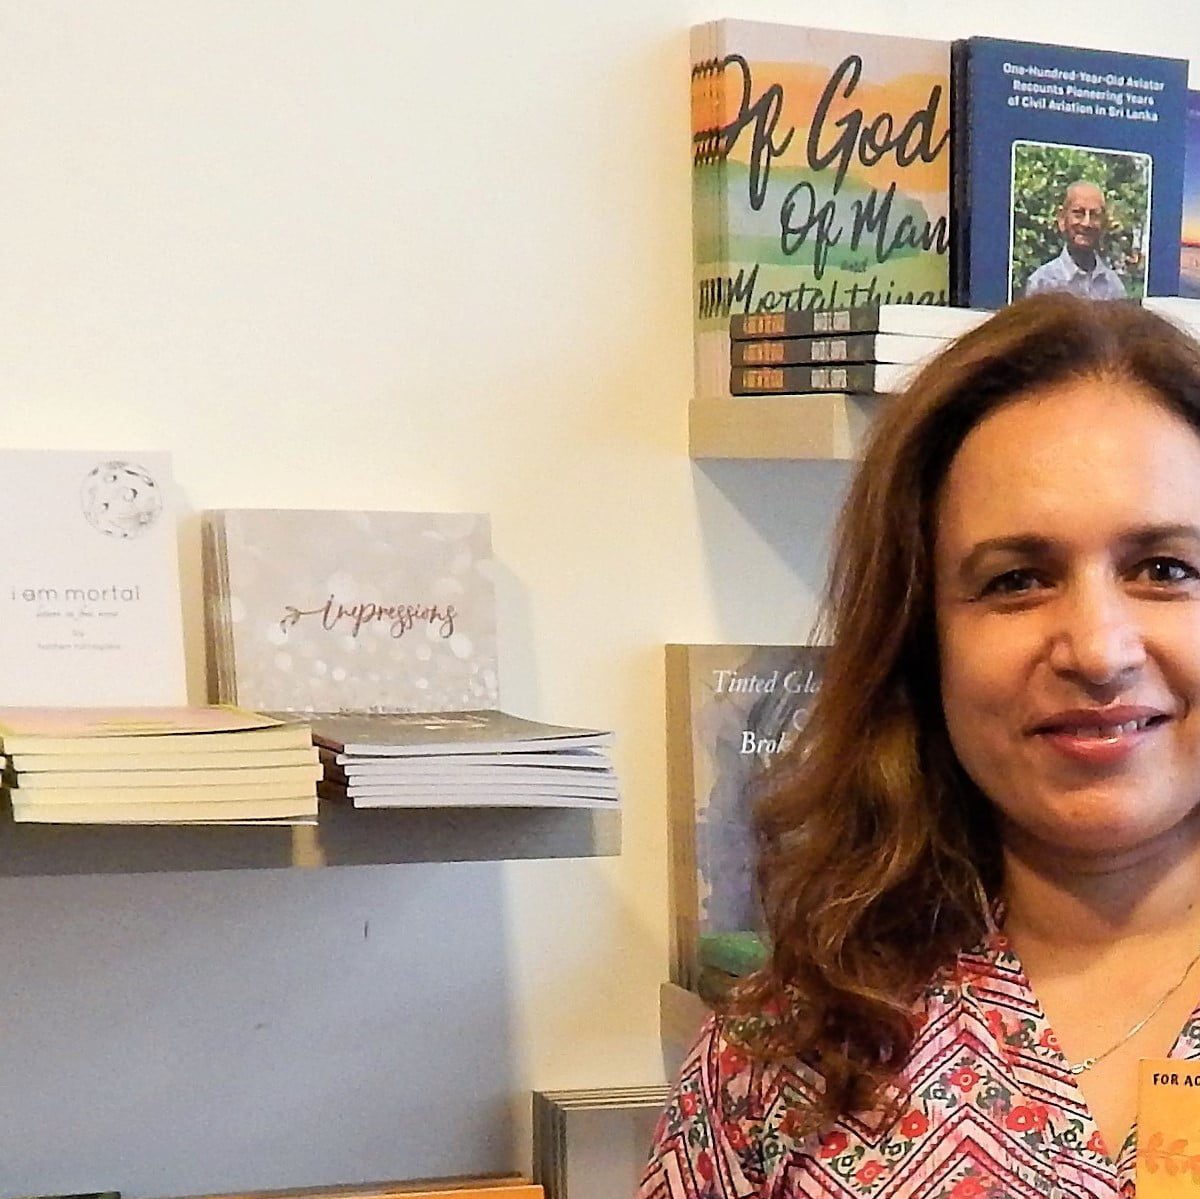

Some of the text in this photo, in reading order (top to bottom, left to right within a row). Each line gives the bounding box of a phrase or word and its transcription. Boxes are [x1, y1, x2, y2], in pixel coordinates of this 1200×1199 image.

[1013, 80, 1155, 106] Recounts Pioneering Years
[1021, 96, 1046, 109] Civil
[1048, 99, 1093, 115] Aviation
[1095, 105, 1106, 116] in
[1108, 106, 1124, 118] Sri
[1126, 108, 1159, 122] Lanka
[808, 55, 950, 194] God
[780, 181, 949, 280] Of Man
[23, 588, 58, 601] am
[65, 585, 140, 601] mortal
[712, 669, 779, 693] Tinted
[1153, 1073, 1179, 1086] FOR
